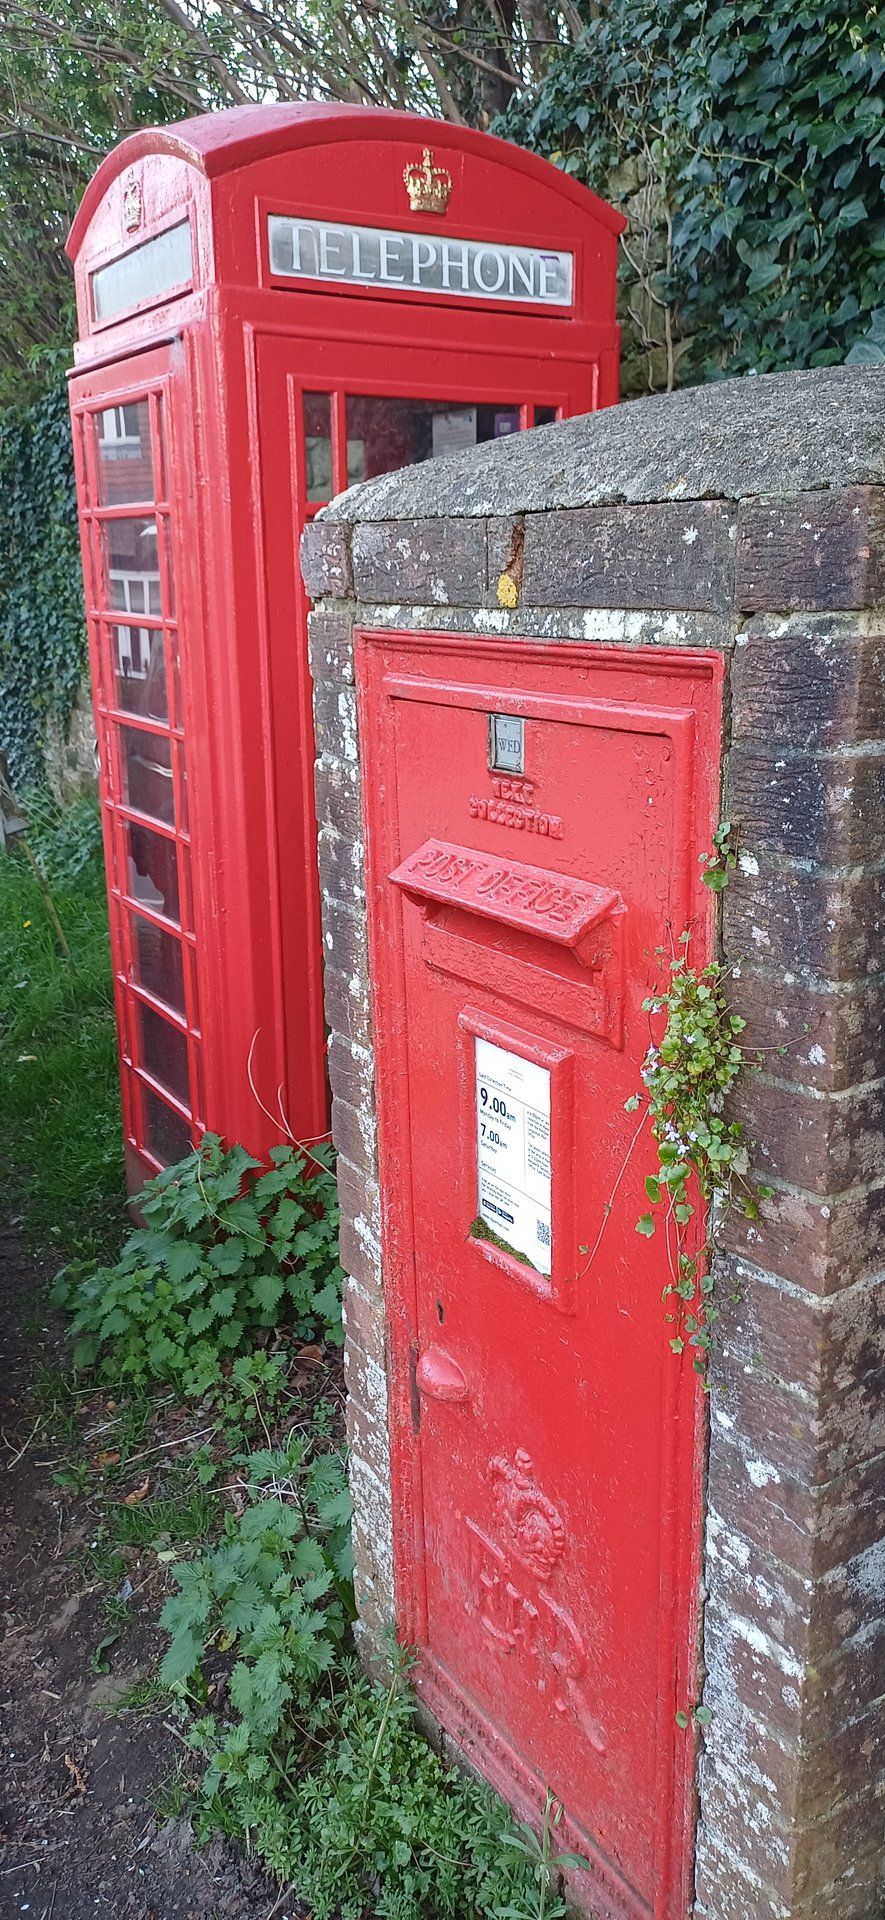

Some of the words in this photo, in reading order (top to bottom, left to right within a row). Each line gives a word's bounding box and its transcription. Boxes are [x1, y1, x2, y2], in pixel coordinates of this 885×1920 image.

[280, 221, 561, 299] TELEPHONE
[498, 738, 521, 754] WED
[469, 795, 564, 840] COLLECTION
[407, 849, 489, 888] POST
[476, 869, 592, 922] OFFICE
[479, 1108, 495, 1122] Monday
[500, 1118, 512, 1131] Friday
[480, 1087, 516, 1123] 9.00am
[480, 1122, 508, 1149] 7.00am
[480, 1139, 498, 1154] Saturday
